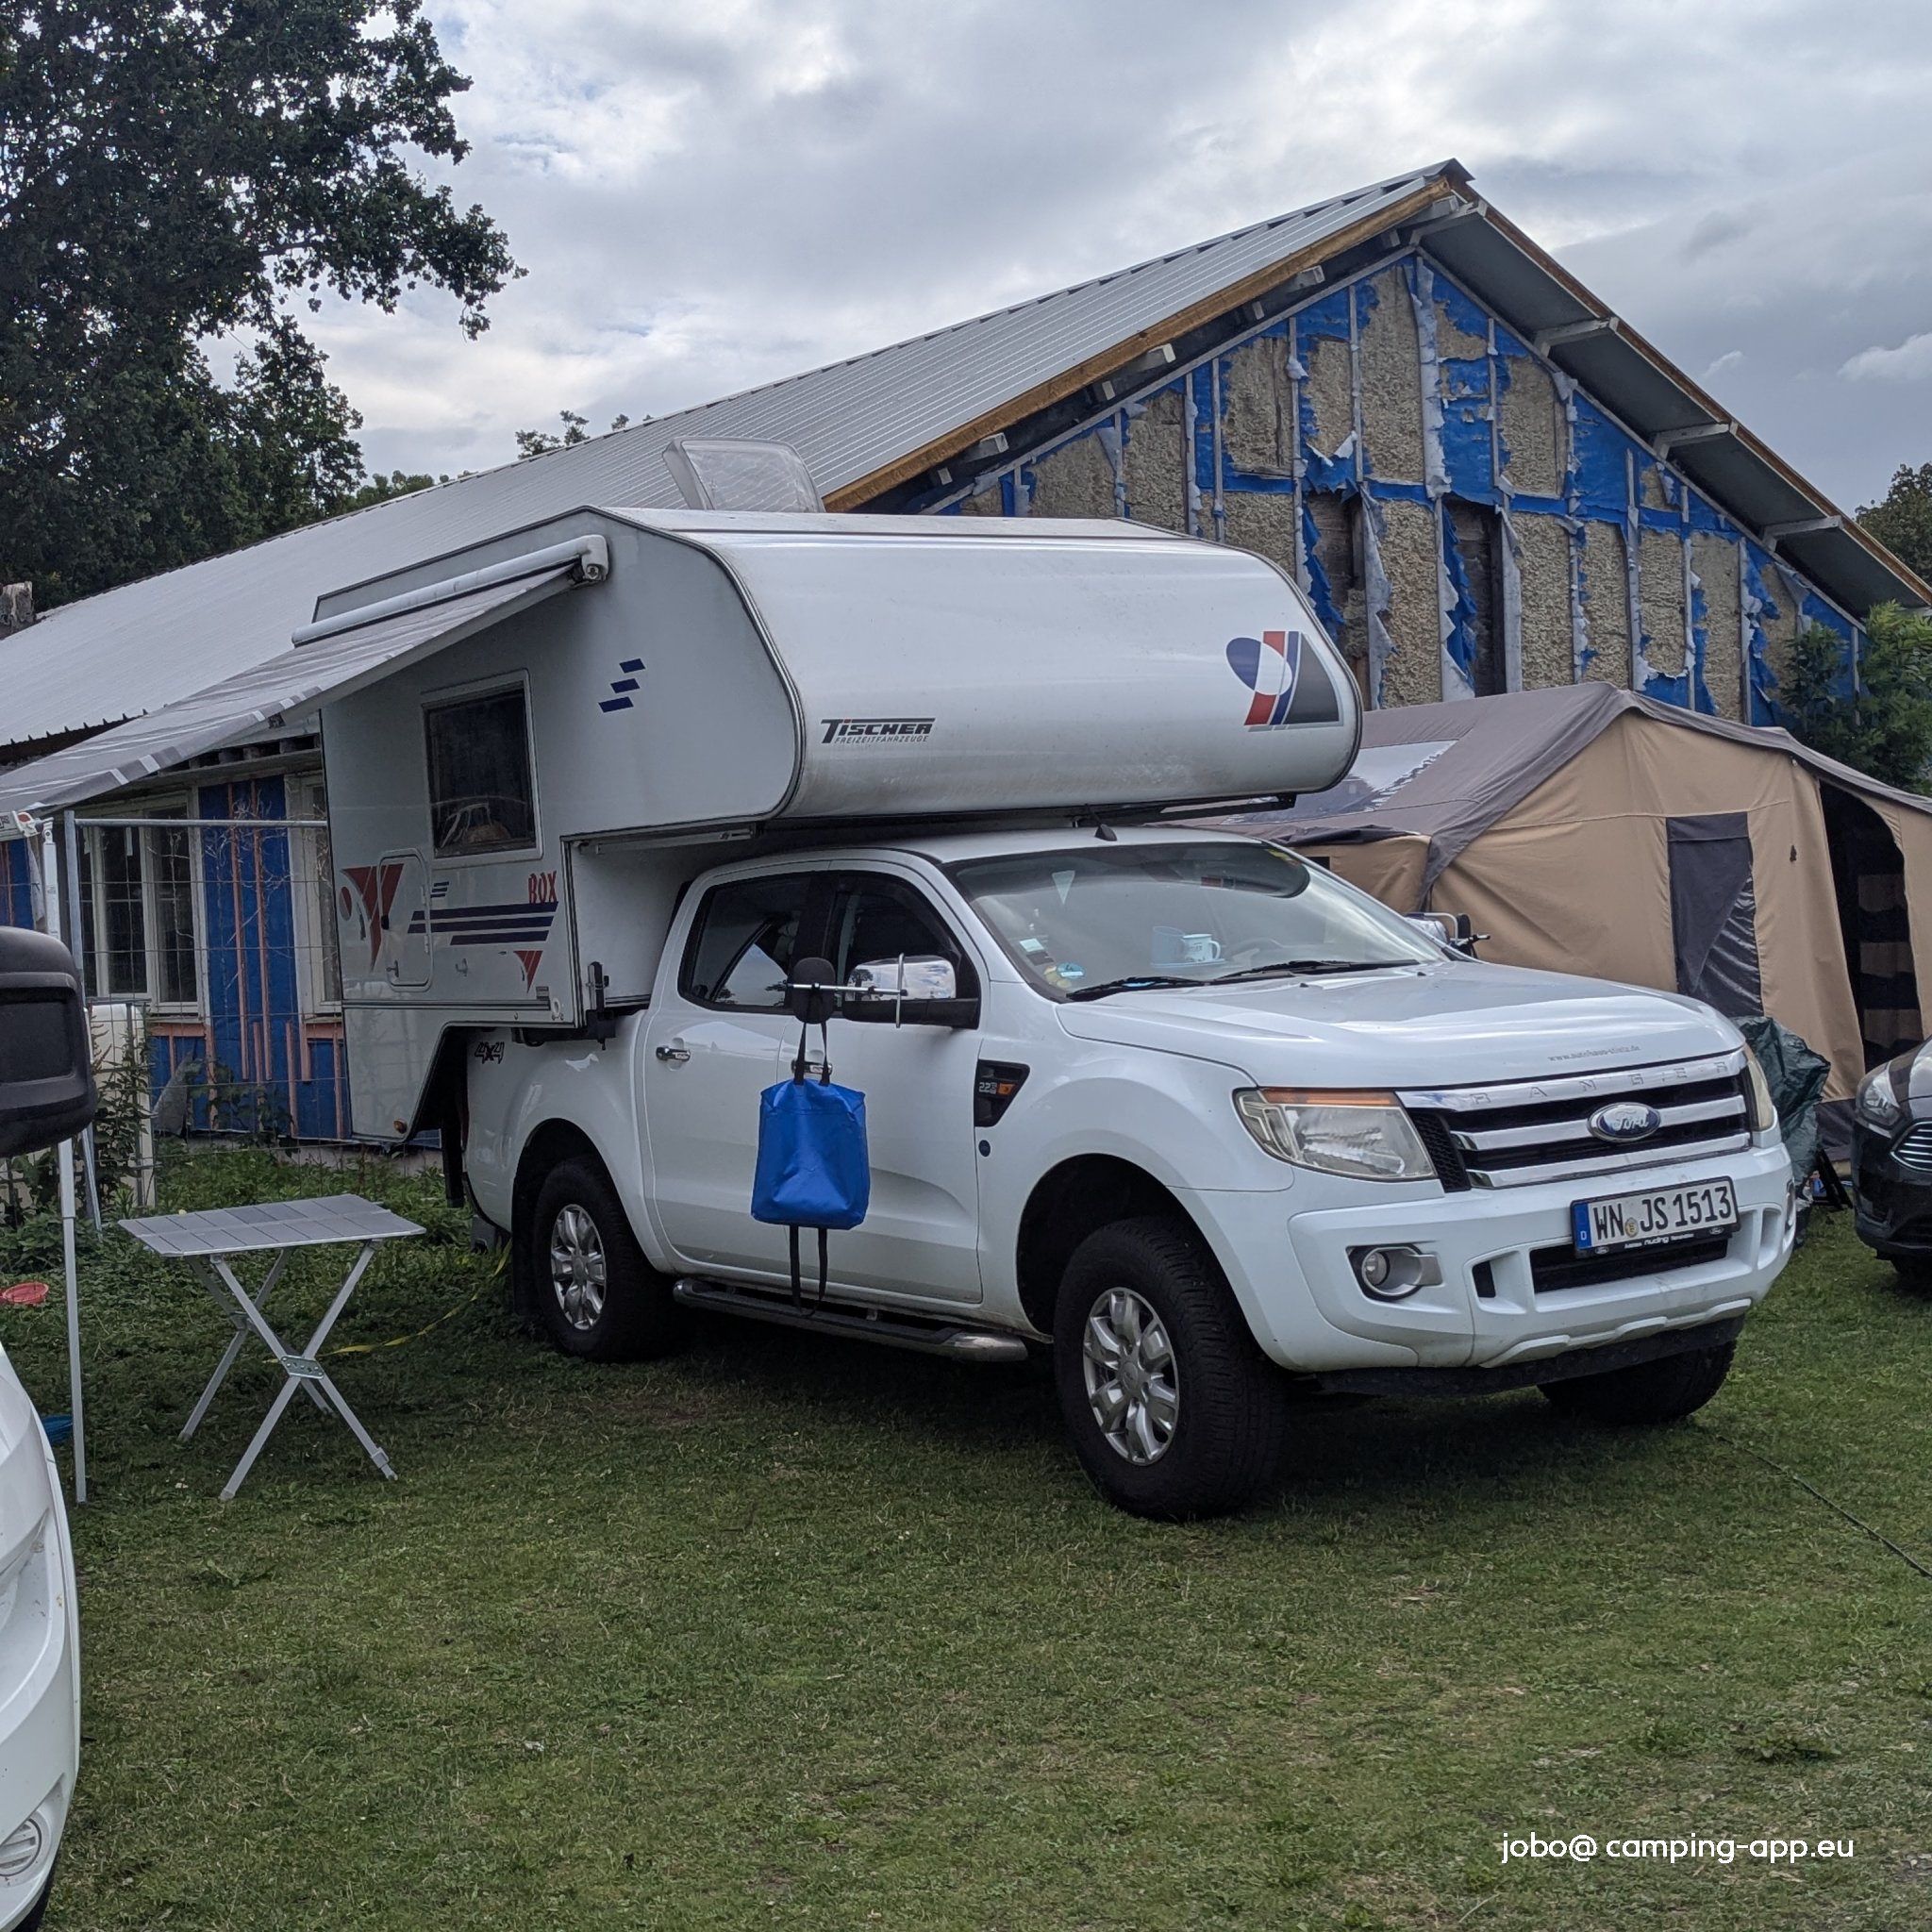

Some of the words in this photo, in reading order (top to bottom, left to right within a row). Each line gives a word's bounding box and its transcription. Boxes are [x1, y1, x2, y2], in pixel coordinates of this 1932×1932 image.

[834, 736, 929, 744] FREIZEITFAHRZEUGE
[527, 870, 558, 904] BOX
[1469, 1061, 1728, 1106] RANGER
[1611, 1109, 1650, 1132] Ford
[1593, 1203, 1624, 1240] WN
[1673, 1186, 1732, 1227] 1513
[1580, 1230, 1588, 1241] D
